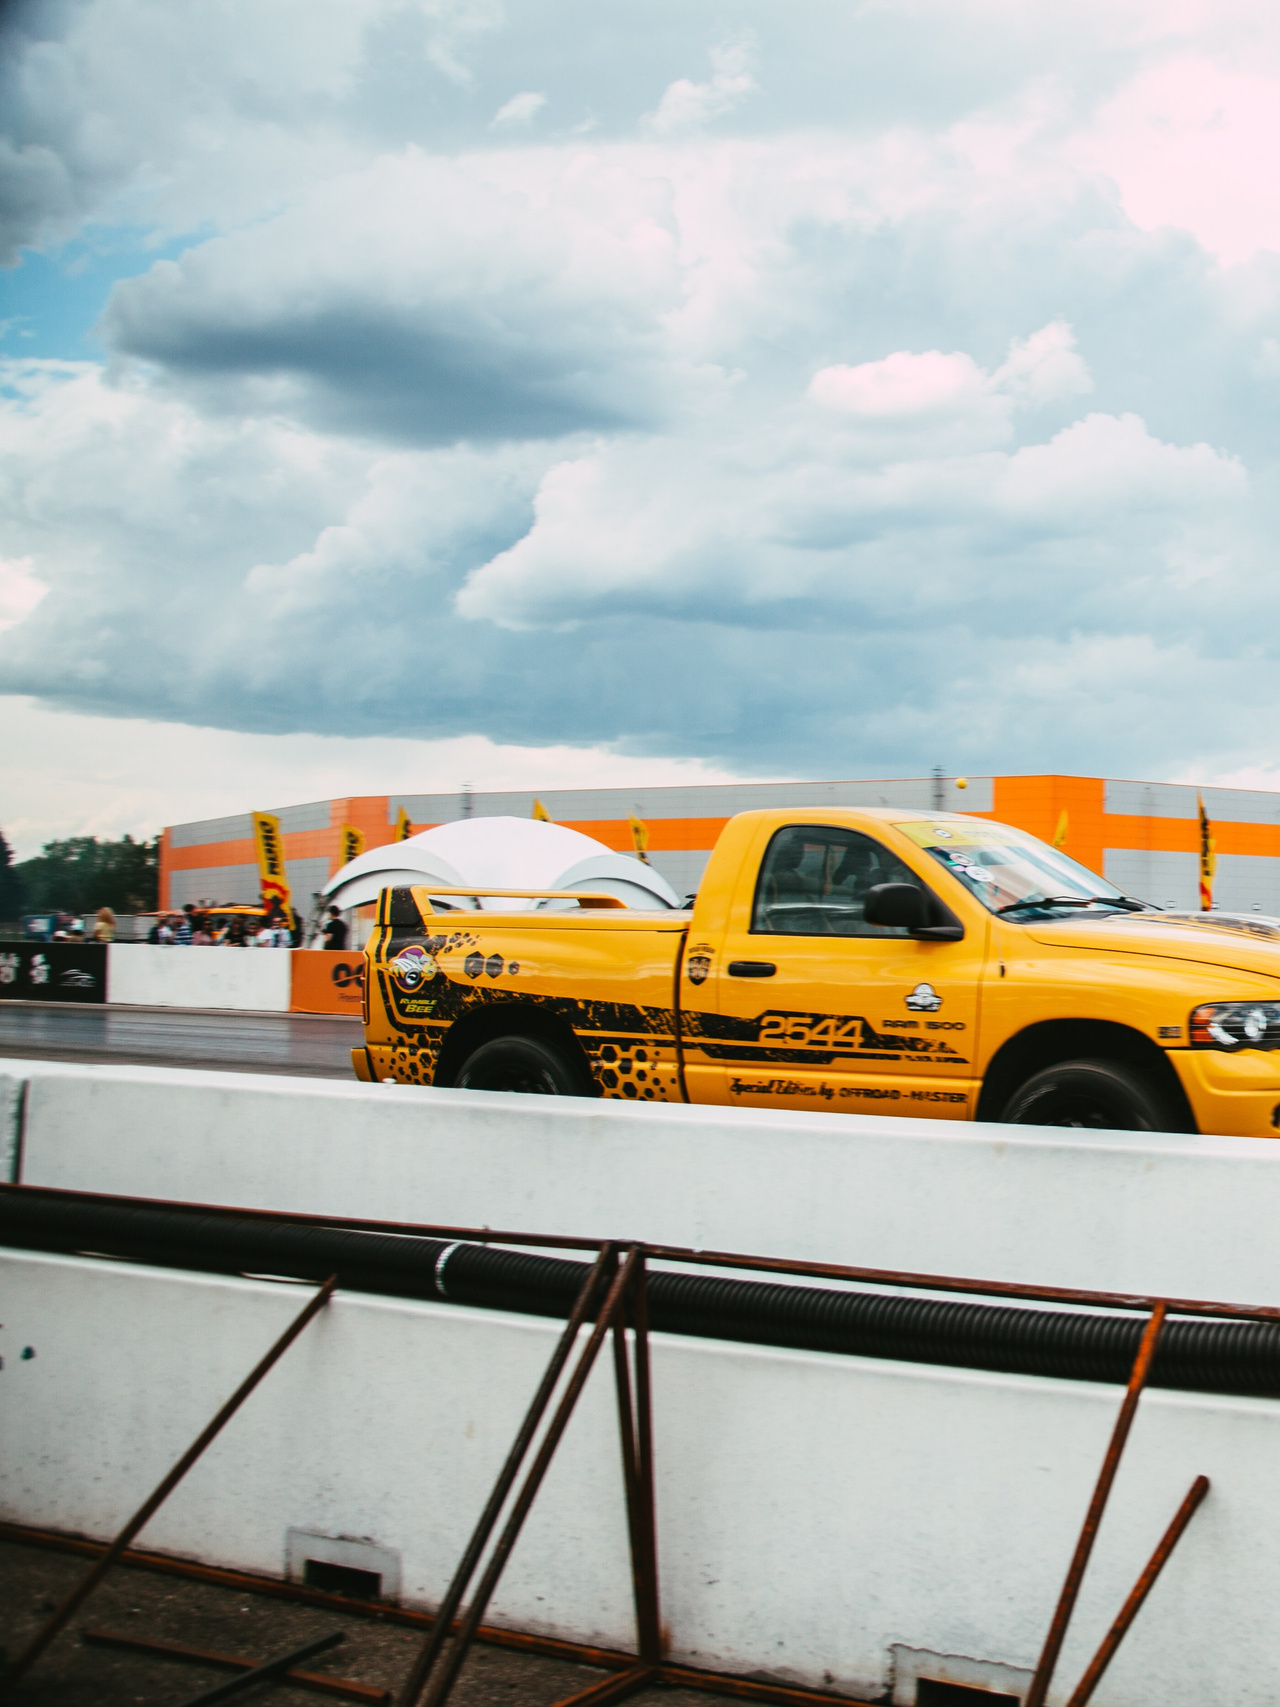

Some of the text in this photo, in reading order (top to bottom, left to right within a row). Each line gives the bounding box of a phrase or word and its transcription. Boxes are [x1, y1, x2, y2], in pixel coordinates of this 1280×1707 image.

[405, 1004, 434, 1013] BEE
[759, 1015, 864, 1048] 2544
[883, 1020, 965, 1030] RAM 1500
[819, 1081, 835, 1100] by
